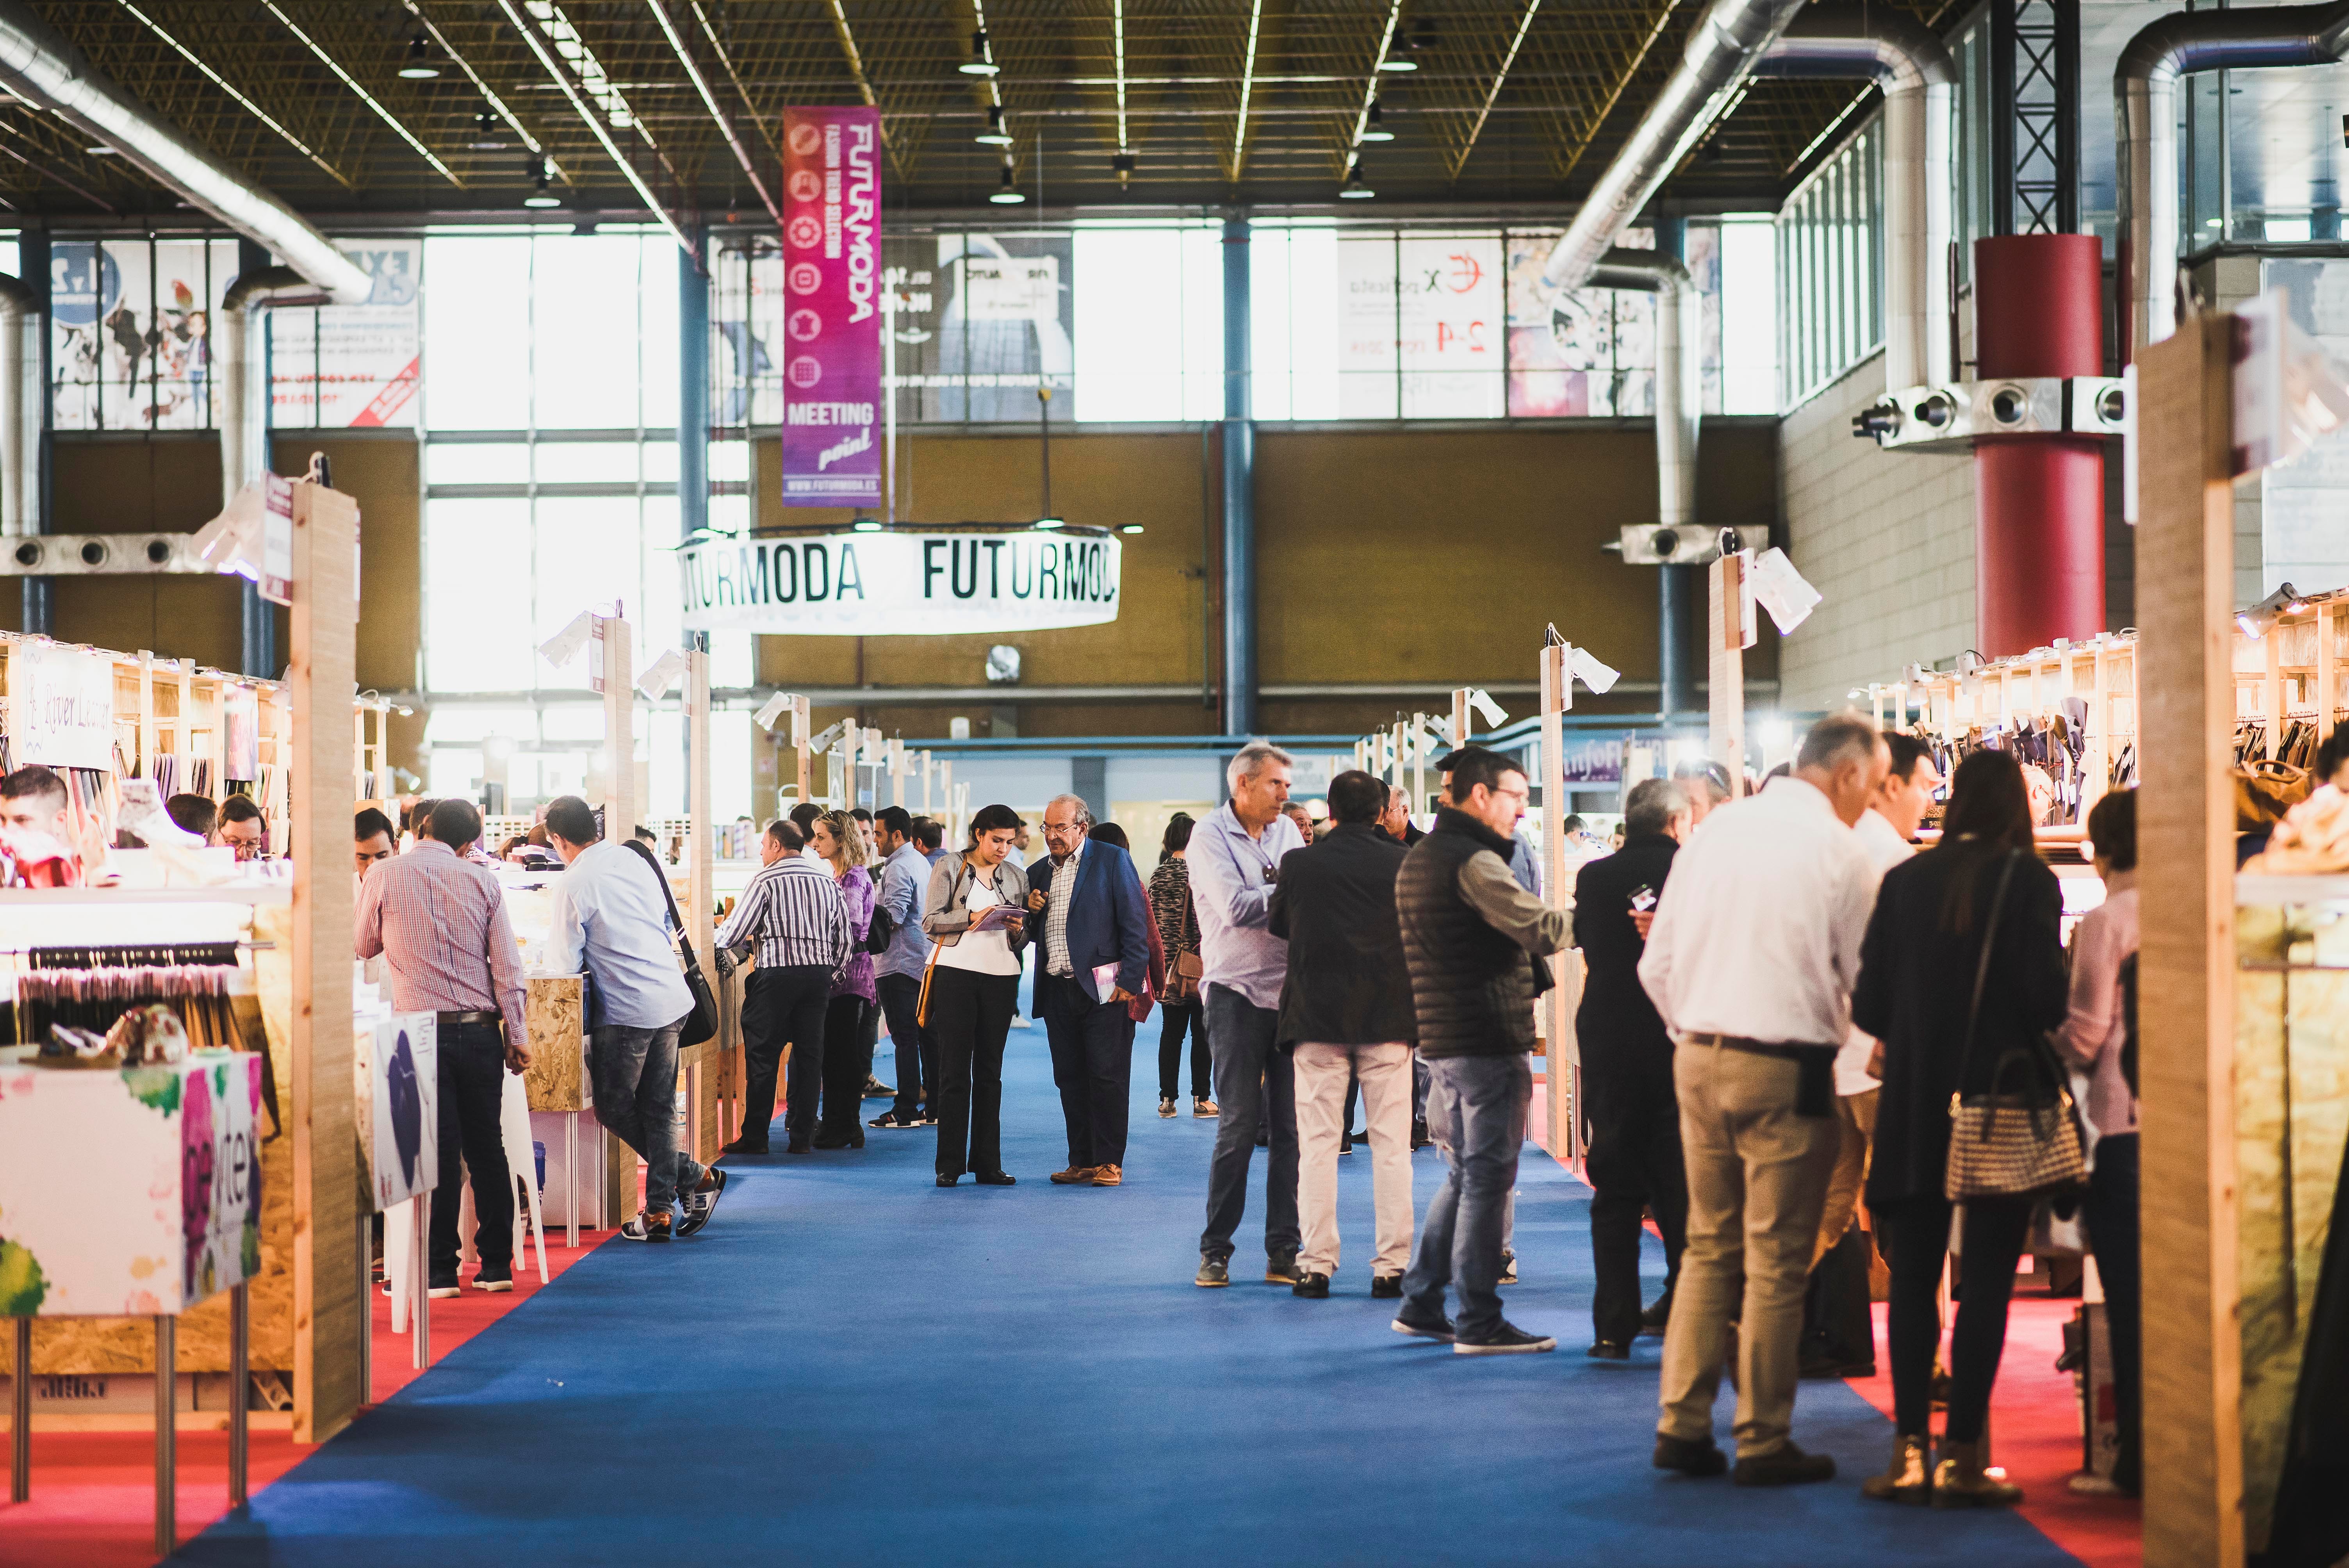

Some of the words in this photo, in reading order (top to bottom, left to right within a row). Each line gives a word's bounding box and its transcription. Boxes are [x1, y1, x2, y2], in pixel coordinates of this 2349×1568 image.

[843, 123, 874, 324] FUTURMODA
[788, 402, 874, 426] MEETING
[818, 427, 873, 472] point
[44, 682, 75, 734] River
